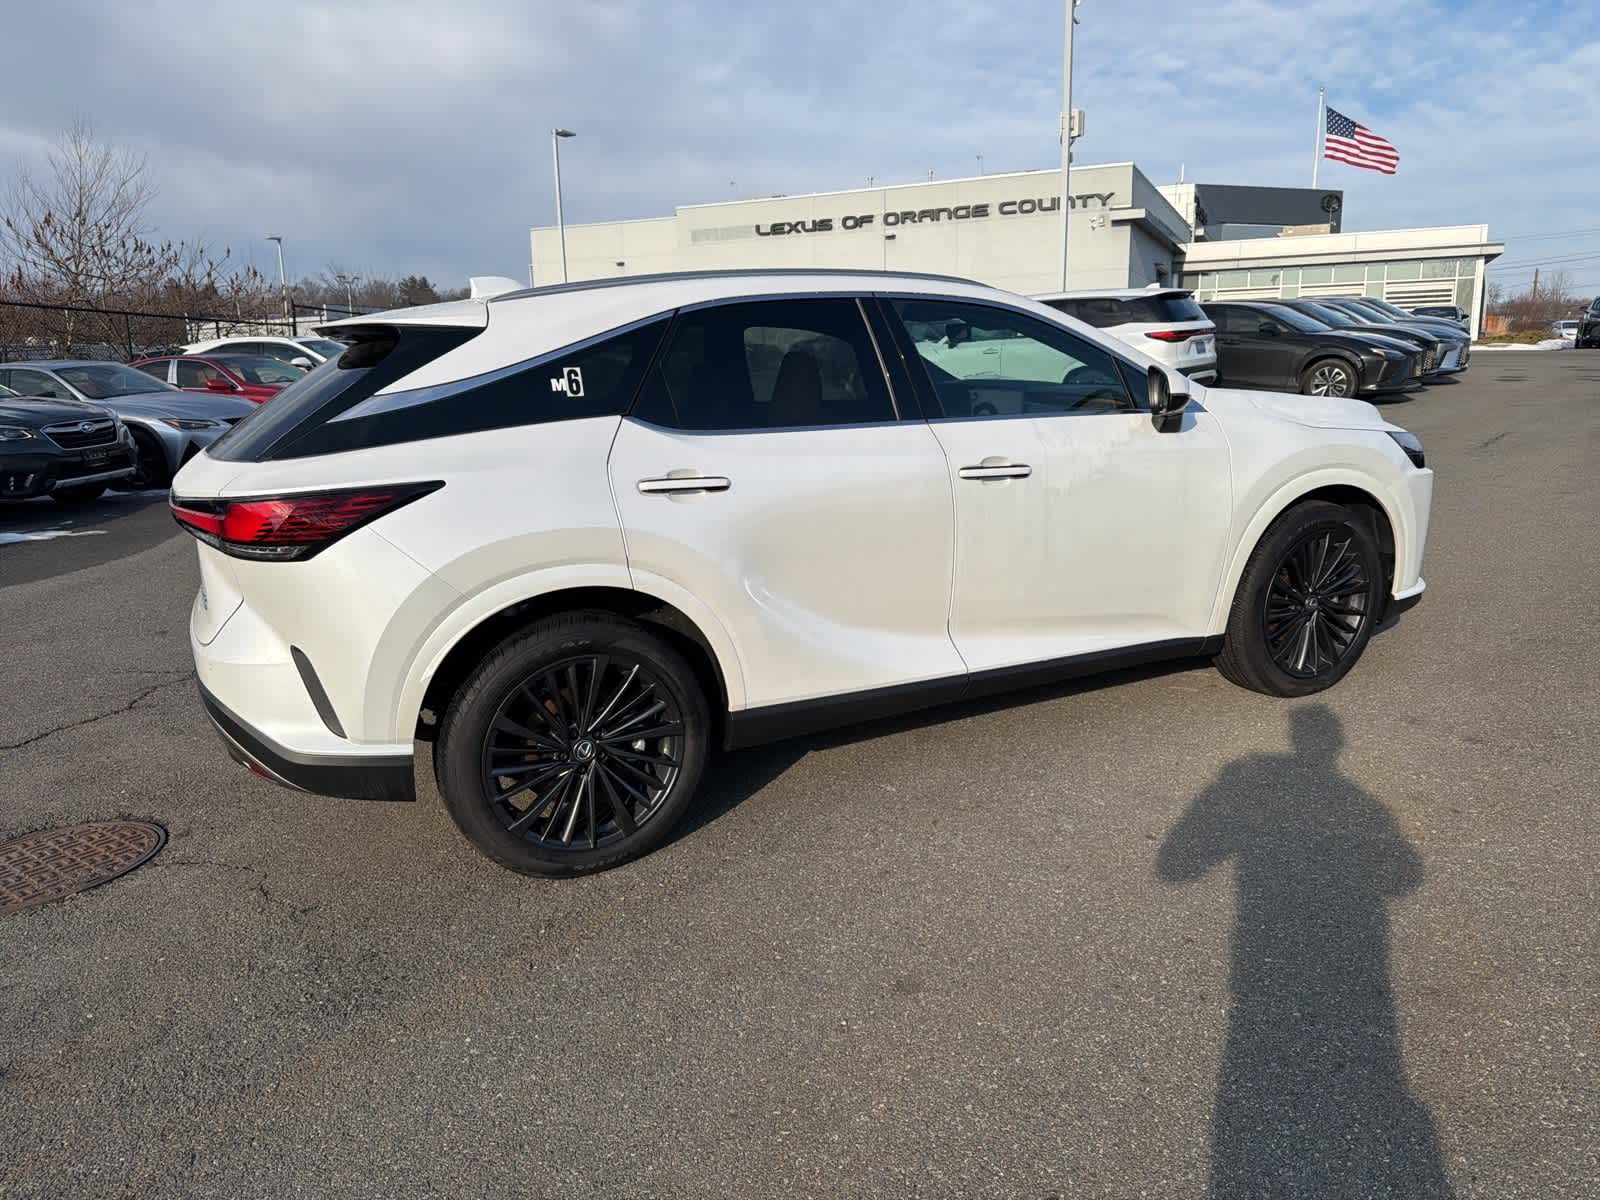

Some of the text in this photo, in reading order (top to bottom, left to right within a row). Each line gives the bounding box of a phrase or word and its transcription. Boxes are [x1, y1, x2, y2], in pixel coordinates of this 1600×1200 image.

[755, 218, 833, 236] LEXUS
[841, 214, 874, 230] OF
[883, 203, 989, 226] ORANGE
